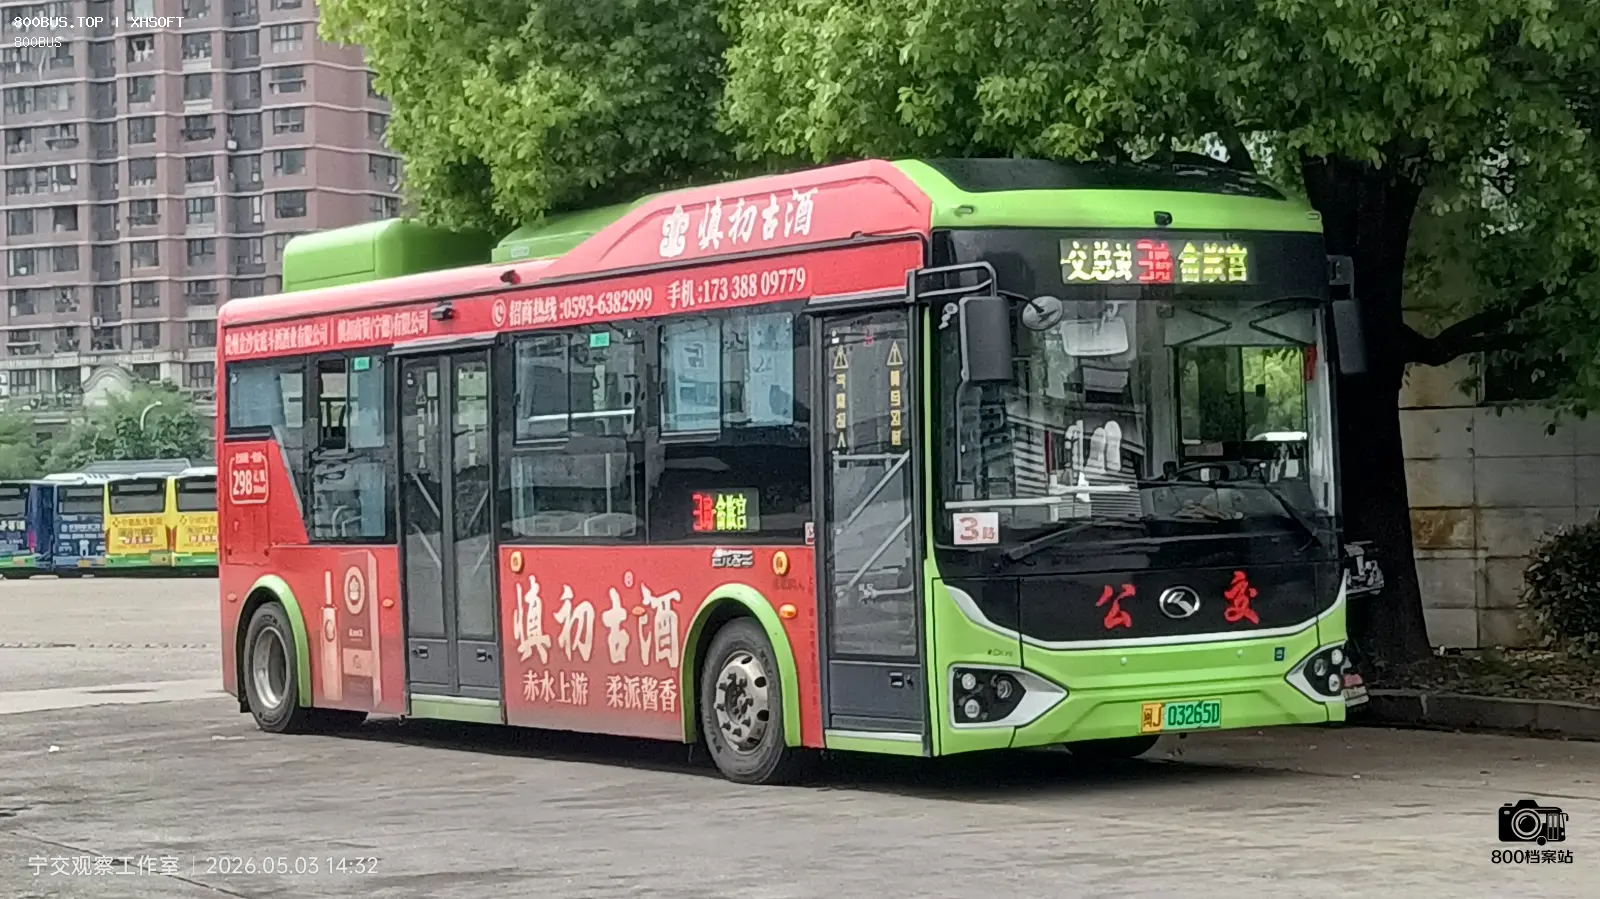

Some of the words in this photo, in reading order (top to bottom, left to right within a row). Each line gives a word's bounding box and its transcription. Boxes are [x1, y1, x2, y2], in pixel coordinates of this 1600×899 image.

[760, 266, 807, 295] 09779
[232, 469, 253, 496] 298
[1095, 583, 1137, 629] 公
[1223, 570, 1260, 625] 交
[522, 669, 589, 706] 赤水上游
[606, 674, 678, 713] 柔派酱香
